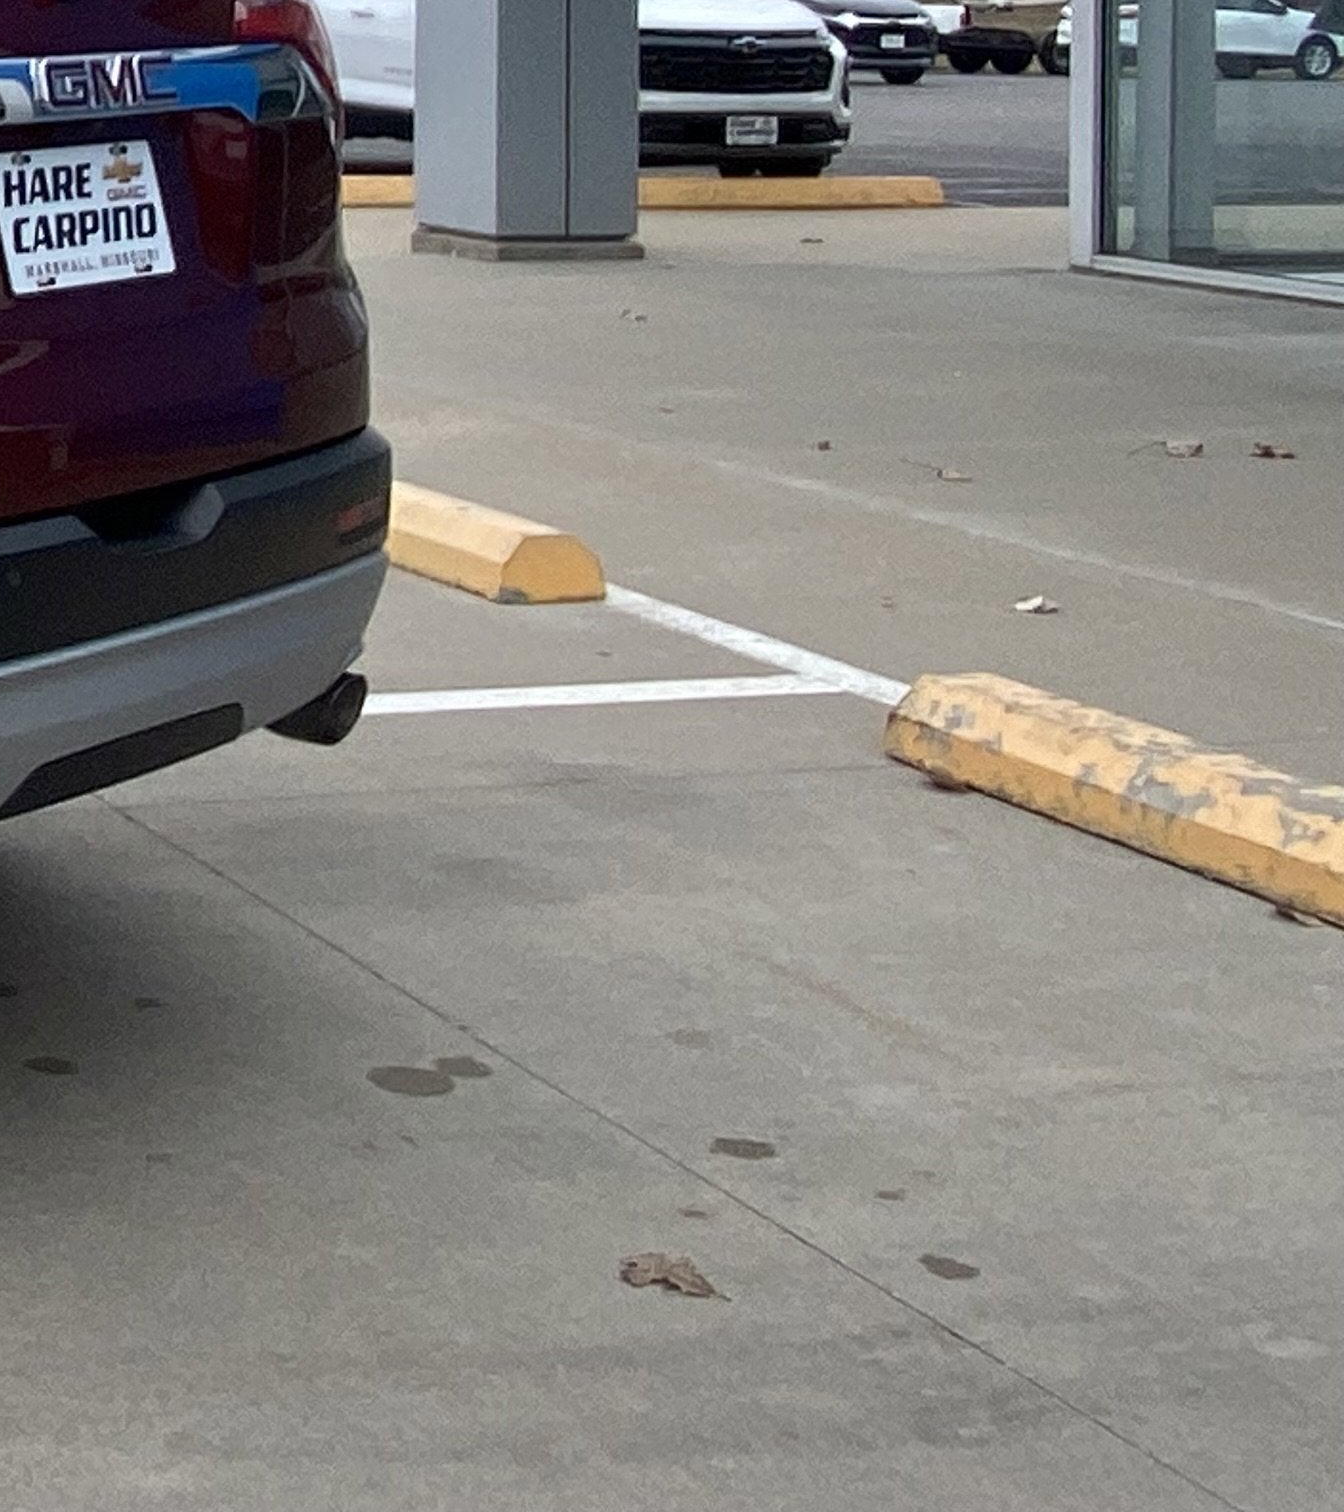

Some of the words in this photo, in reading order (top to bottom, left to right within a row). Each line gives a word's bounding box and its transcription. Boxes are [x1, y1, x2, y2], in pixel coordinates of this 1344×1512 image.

[40, 55, 179, 108] GMC
[3, 163, 92, 207] HARE
[13, 203, 157, 254] CARPINO
